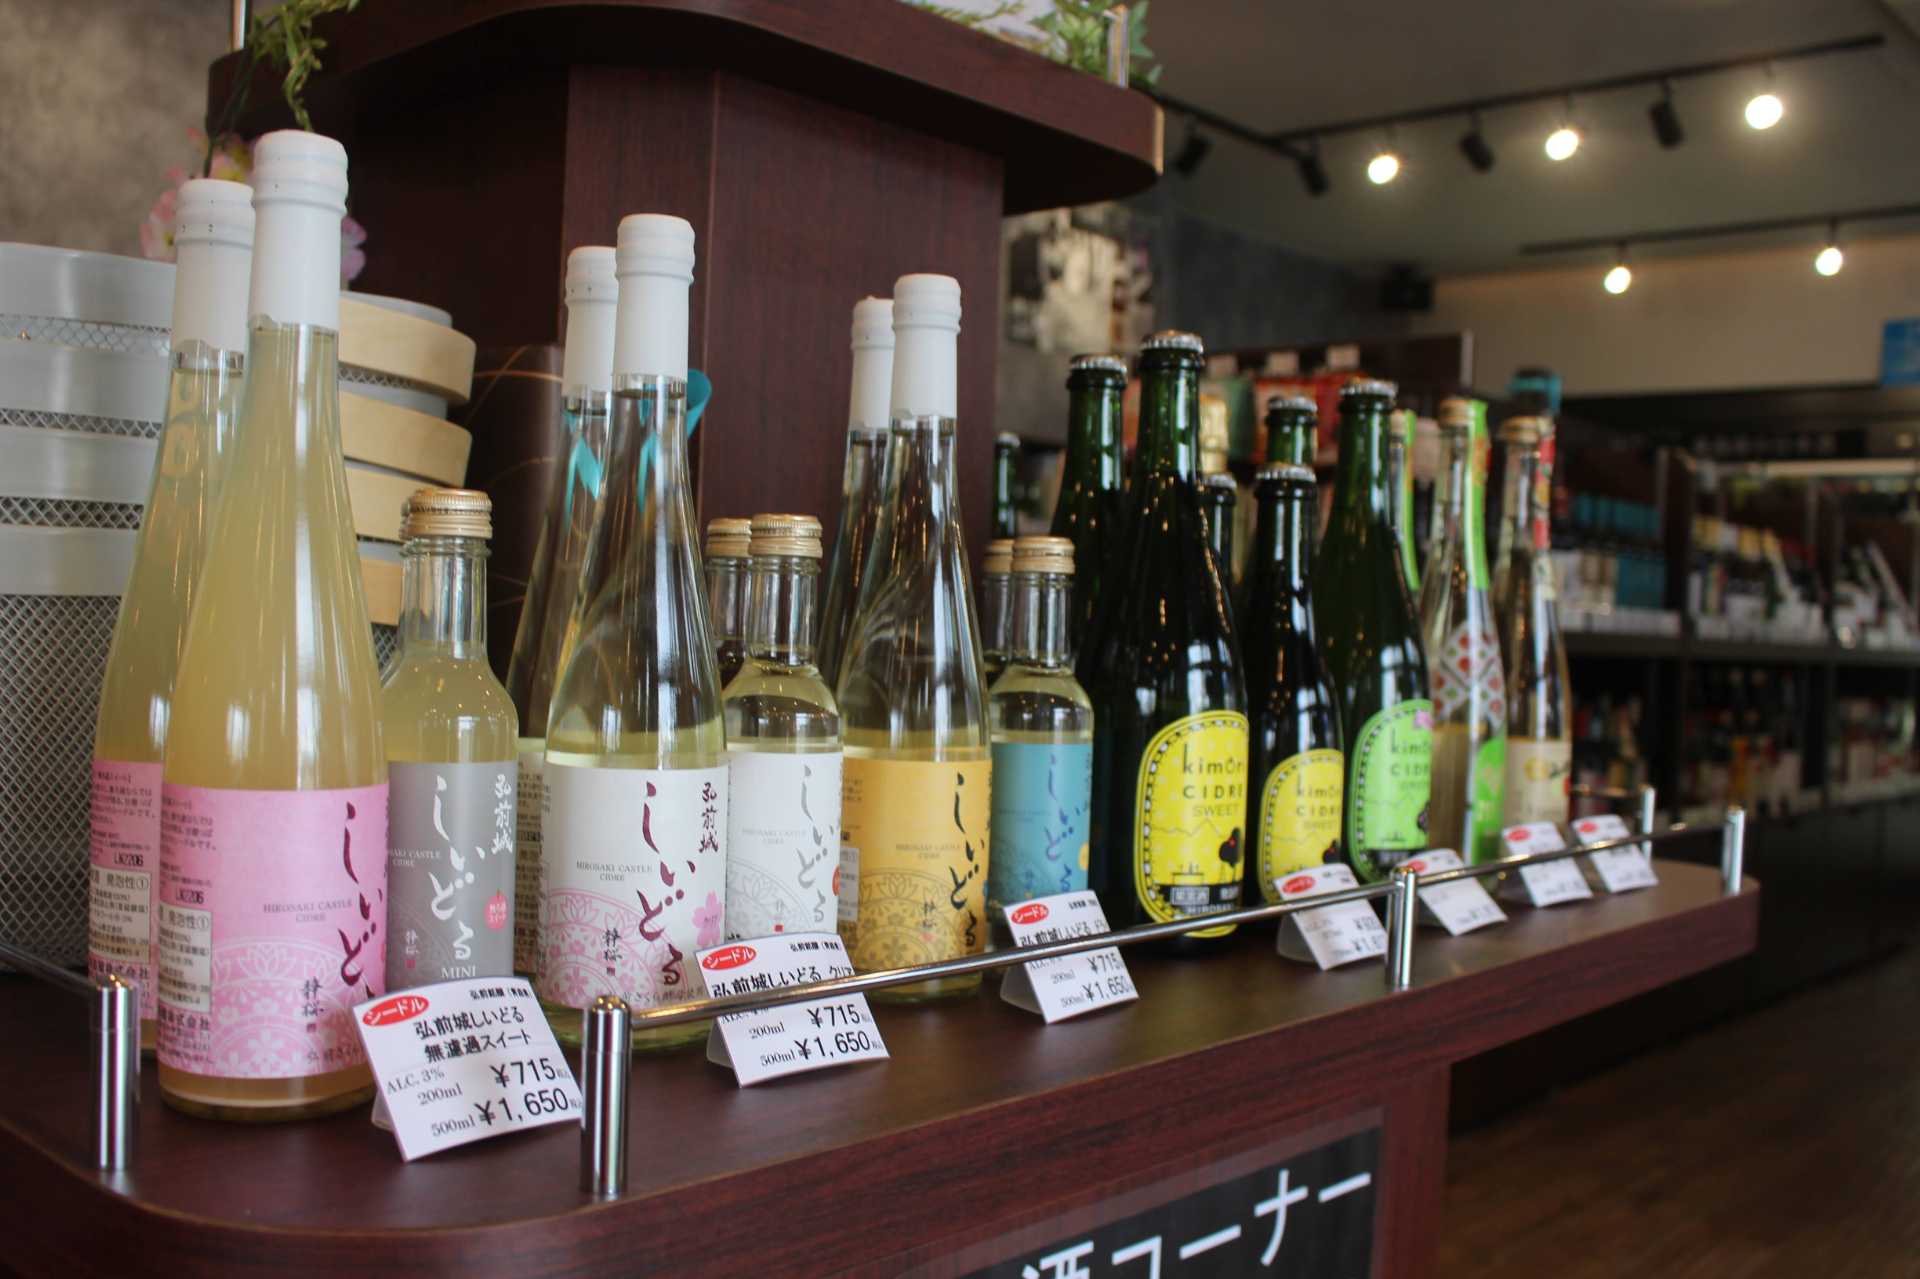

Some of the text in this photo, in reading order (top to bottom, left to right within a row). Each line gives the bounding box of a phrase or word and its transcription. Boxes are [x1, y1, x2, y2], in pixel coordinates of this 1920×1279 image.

[263, 902, 316, 913] HIROSAKI
[441, 965, 476, 979] MINI
[705, 947, 756, 969] シードル
[711, 965, 822, 998] 弘前城しいどる
[364, 997, 426, 1024] シードル
[414, 1006, 525, 1040] 弘前城しいどる
[806, 1003, 861, 1029] ¥715
[748, 1021, 786, 1040] 200ml
[424, 1028, 532, 1063] 無濾過スイート
[760, 1048, 796, 1067] 500ml
[793, 1030, 870, 1060] ¥1,650
[386, 1066, 446, 1095] ALC. 3%
[489, 1057, 556, 1088] ¥715
[417, 1083, 463, 1106] 200ml
[430, 1114, 476, 1137] 500ml
[474, 1087, 570, 1126] ¥1,650
